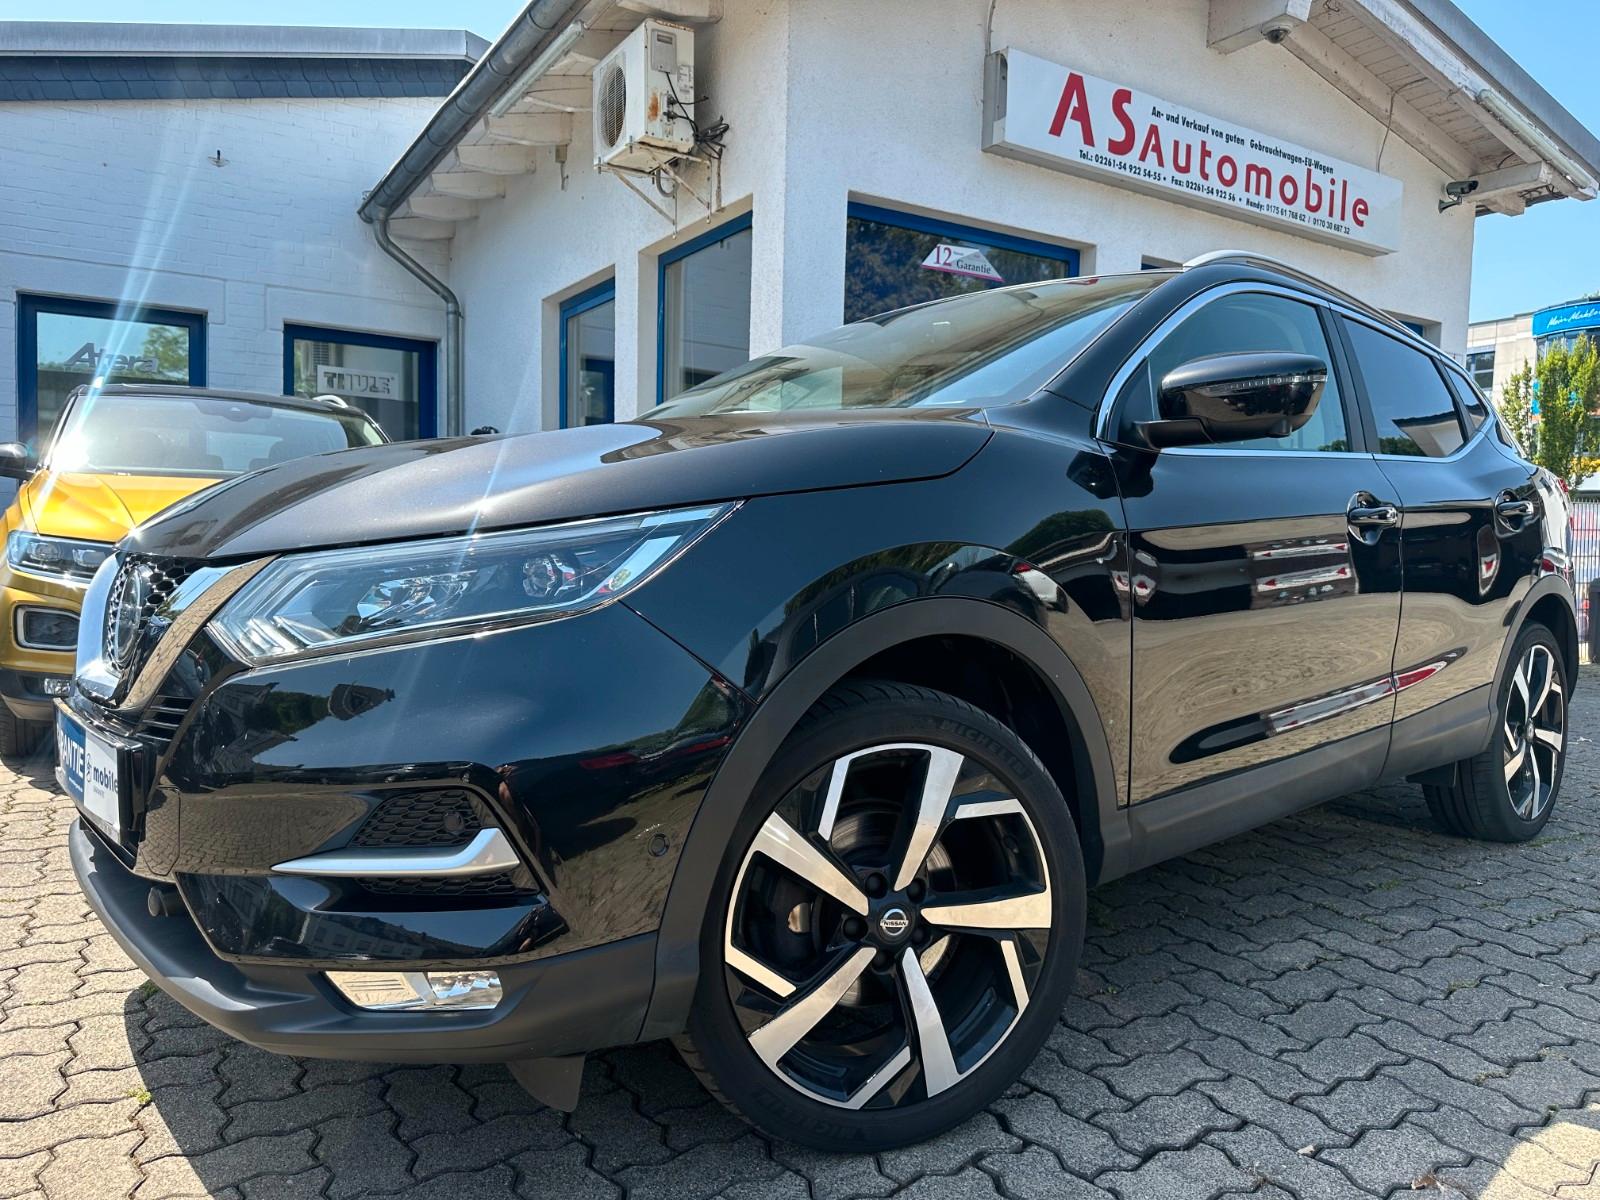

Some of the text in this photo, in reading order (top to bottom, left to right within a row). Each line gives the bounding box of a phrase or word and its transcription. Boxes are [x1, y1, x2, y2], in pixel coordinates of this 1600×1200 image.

[1151, 106, 1164, 118] An-
[1165, 113, 1180, 125] und
[1181, 116, 1210, 134] Verkauf
[1211, 128, 1224, 139] von
[1225, 133, 1245, 146] guten
[1079, 149, 1093, 162] Tel.:
[1094, 154, 1127, 171] 02261-54
[1128, 164, 1141, 176] 922
[1143, 168, 1161, 181] 54-55
[1171, 176, 1184, 187] Fax:
[1185, 180, 1214, 195] 02261-54
[1215, 188, 1227, 199] 922
[1228, 193, 1236, 202] 56
[1246, 198, 1265, 212] Handy:
[1266, 204, 1280, 215] 0175
[1313, 218, 1326, 228] 0170
[1326, 221, 1333, 230] 30
[1344, 226, 1350, 235] 32
[934, 246, 952, 266] 12
[957, 260, 991, 274] Garantie
[63, 342, 158, 372] Atera
